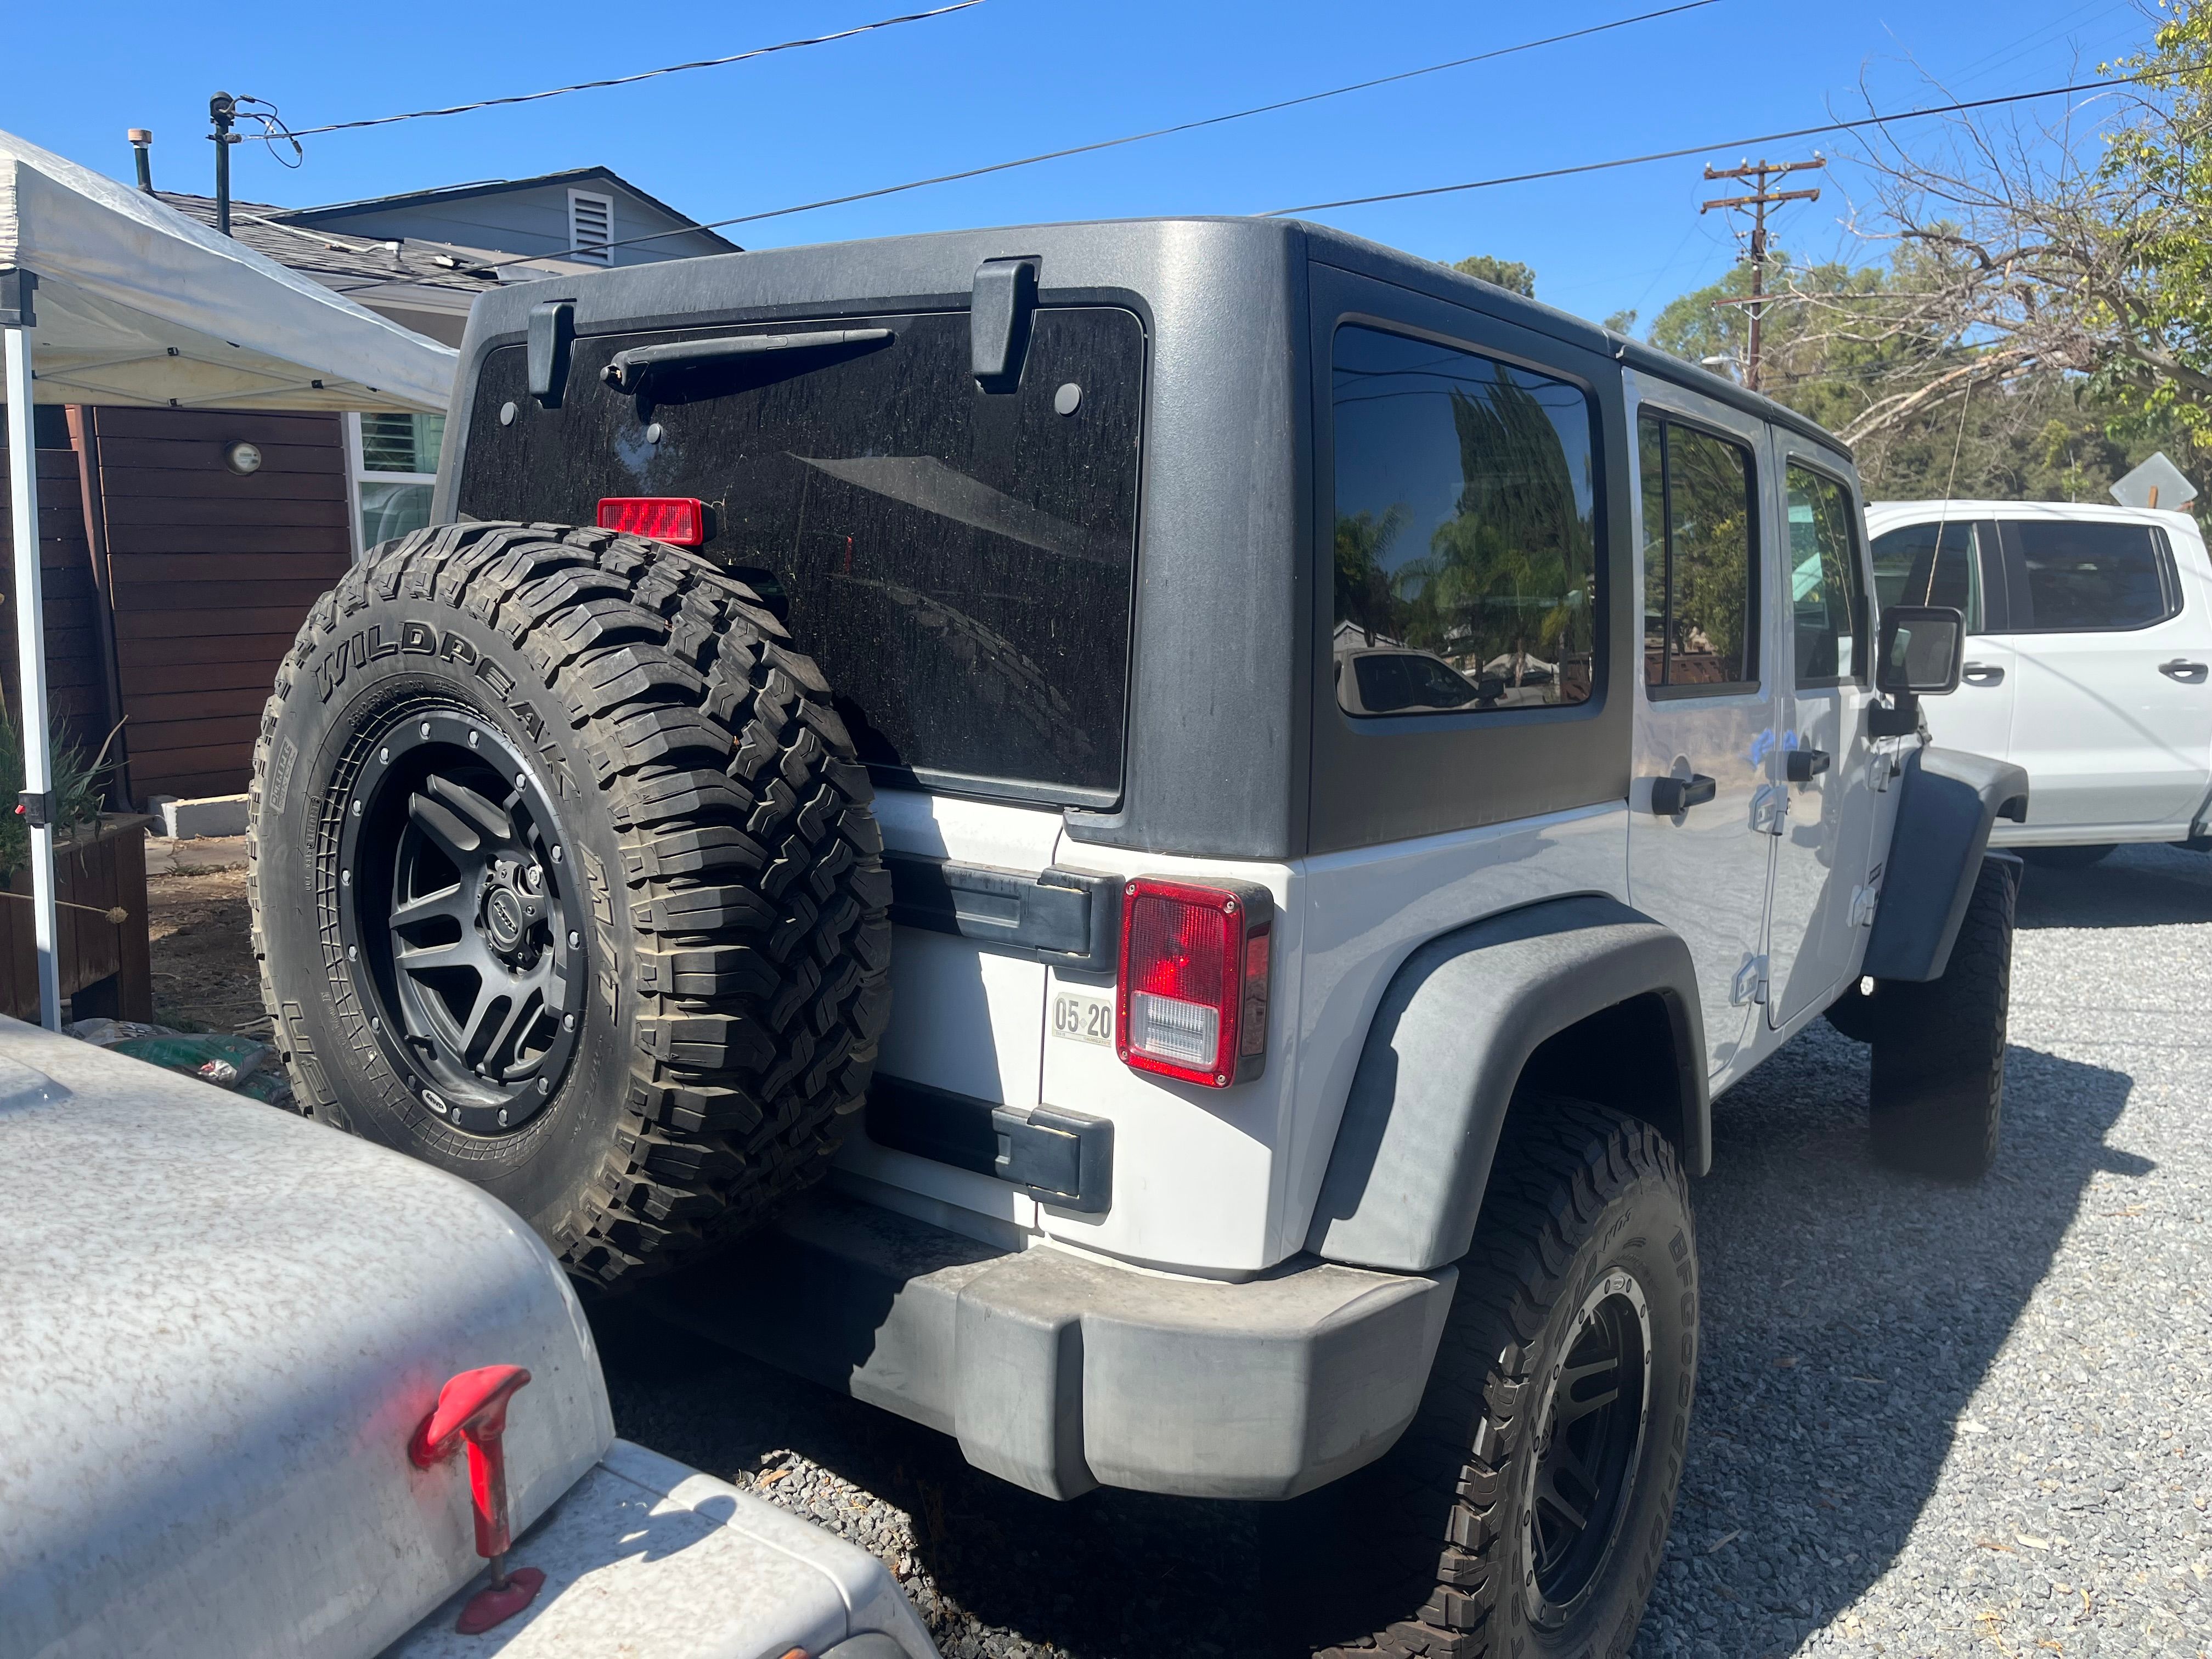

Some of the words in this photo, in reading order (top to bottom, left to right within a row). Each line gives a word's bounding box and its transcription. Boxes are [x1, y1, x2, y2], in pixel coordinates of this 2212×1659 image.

[315, 620, 580, 800] WILDPEAK
[1056, 997, 1079, 1032] 05
[1087, 1003, 1111, 1039] 20
[1636, 1228, 1695, 1599] BFGoodrich
